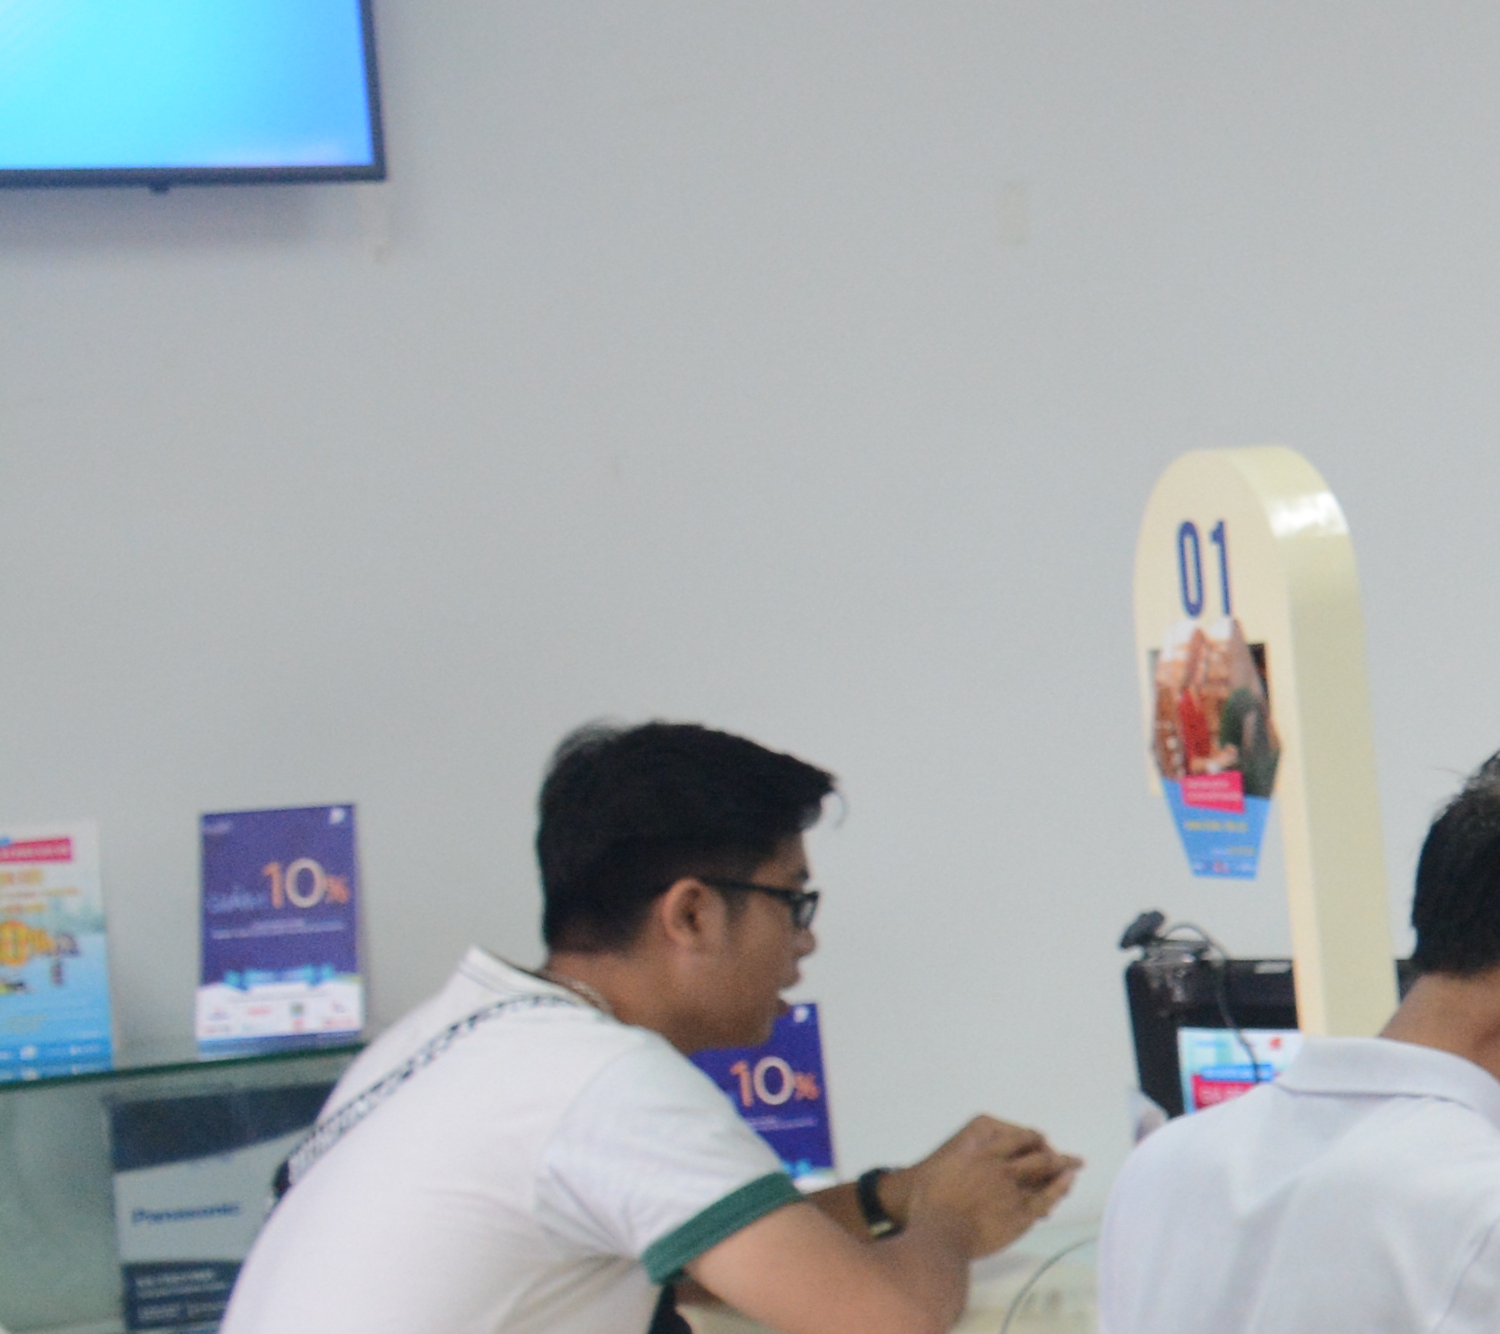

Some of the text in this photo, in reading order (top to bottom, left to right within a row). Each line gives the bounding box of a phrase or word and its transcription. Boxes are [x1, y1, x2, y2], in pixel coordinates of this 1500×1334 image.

[1176, 519, 1233, 618] 01
[261, 857, 349, 909] 10%
[729, 1055, 820, 1108] 10%
